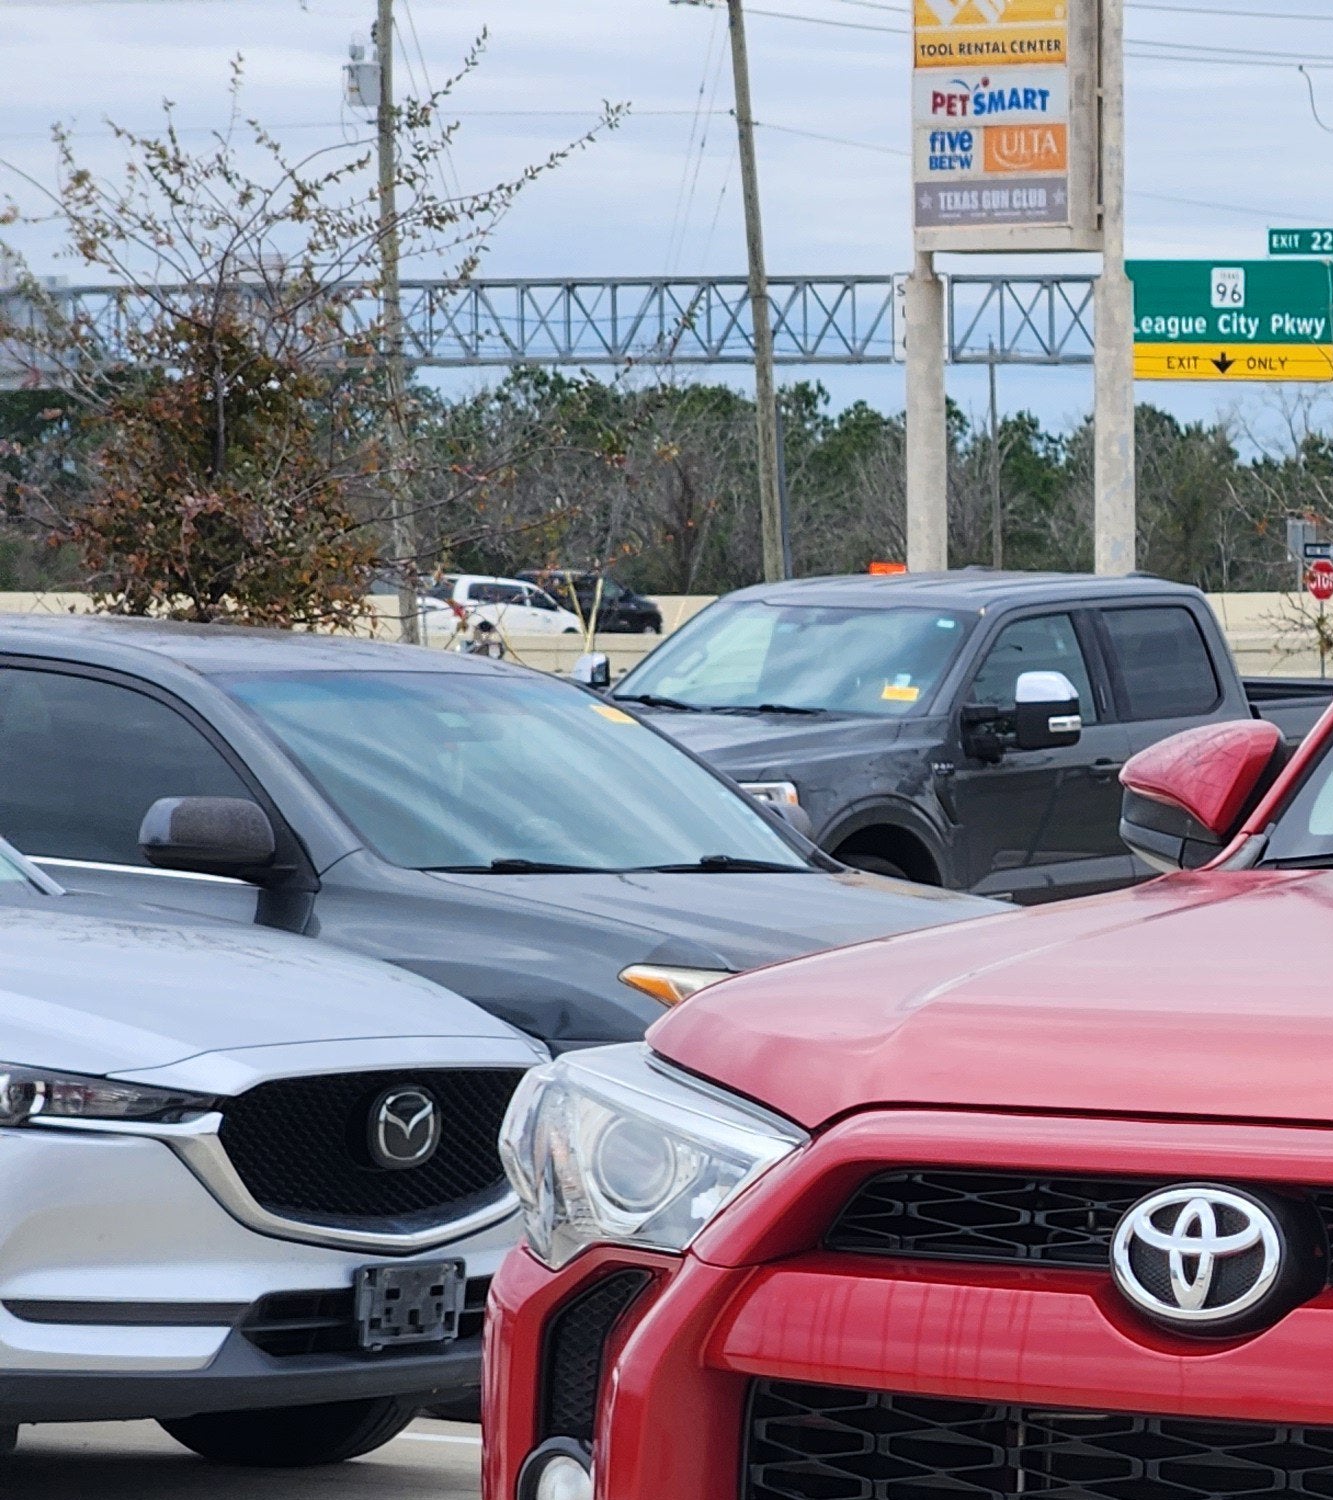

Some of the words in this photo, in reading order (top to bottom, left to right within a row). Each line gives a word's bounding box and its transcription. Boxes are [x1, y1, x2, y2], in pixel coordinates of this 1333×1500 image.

[920, 43, 954, 56] TOOL
[958, 41, 1007, 56] RENTAL
[1010, 39, 1061, 53] CENTER
[931, 86, 1050, 117] PETSMART
[1001, 129, 1059, 156] ULTA
[939, 190, 979, 211] TEXAS
[981, 189, 1010, 209] GUN
[1012, 188, 1047, 208] CLUB
[1271, 234, 1300, 249] EXIT
[1310, 232, 1333, 250] 22
[1216, 282, 1242, 303] 96
[1217, 312, 1260, 338] City
[1271, 312, 1326, 340] Pkwy
[1166, 355, 1199, 370] EXIT
[1247, 355, 1289, 371] ONLY
